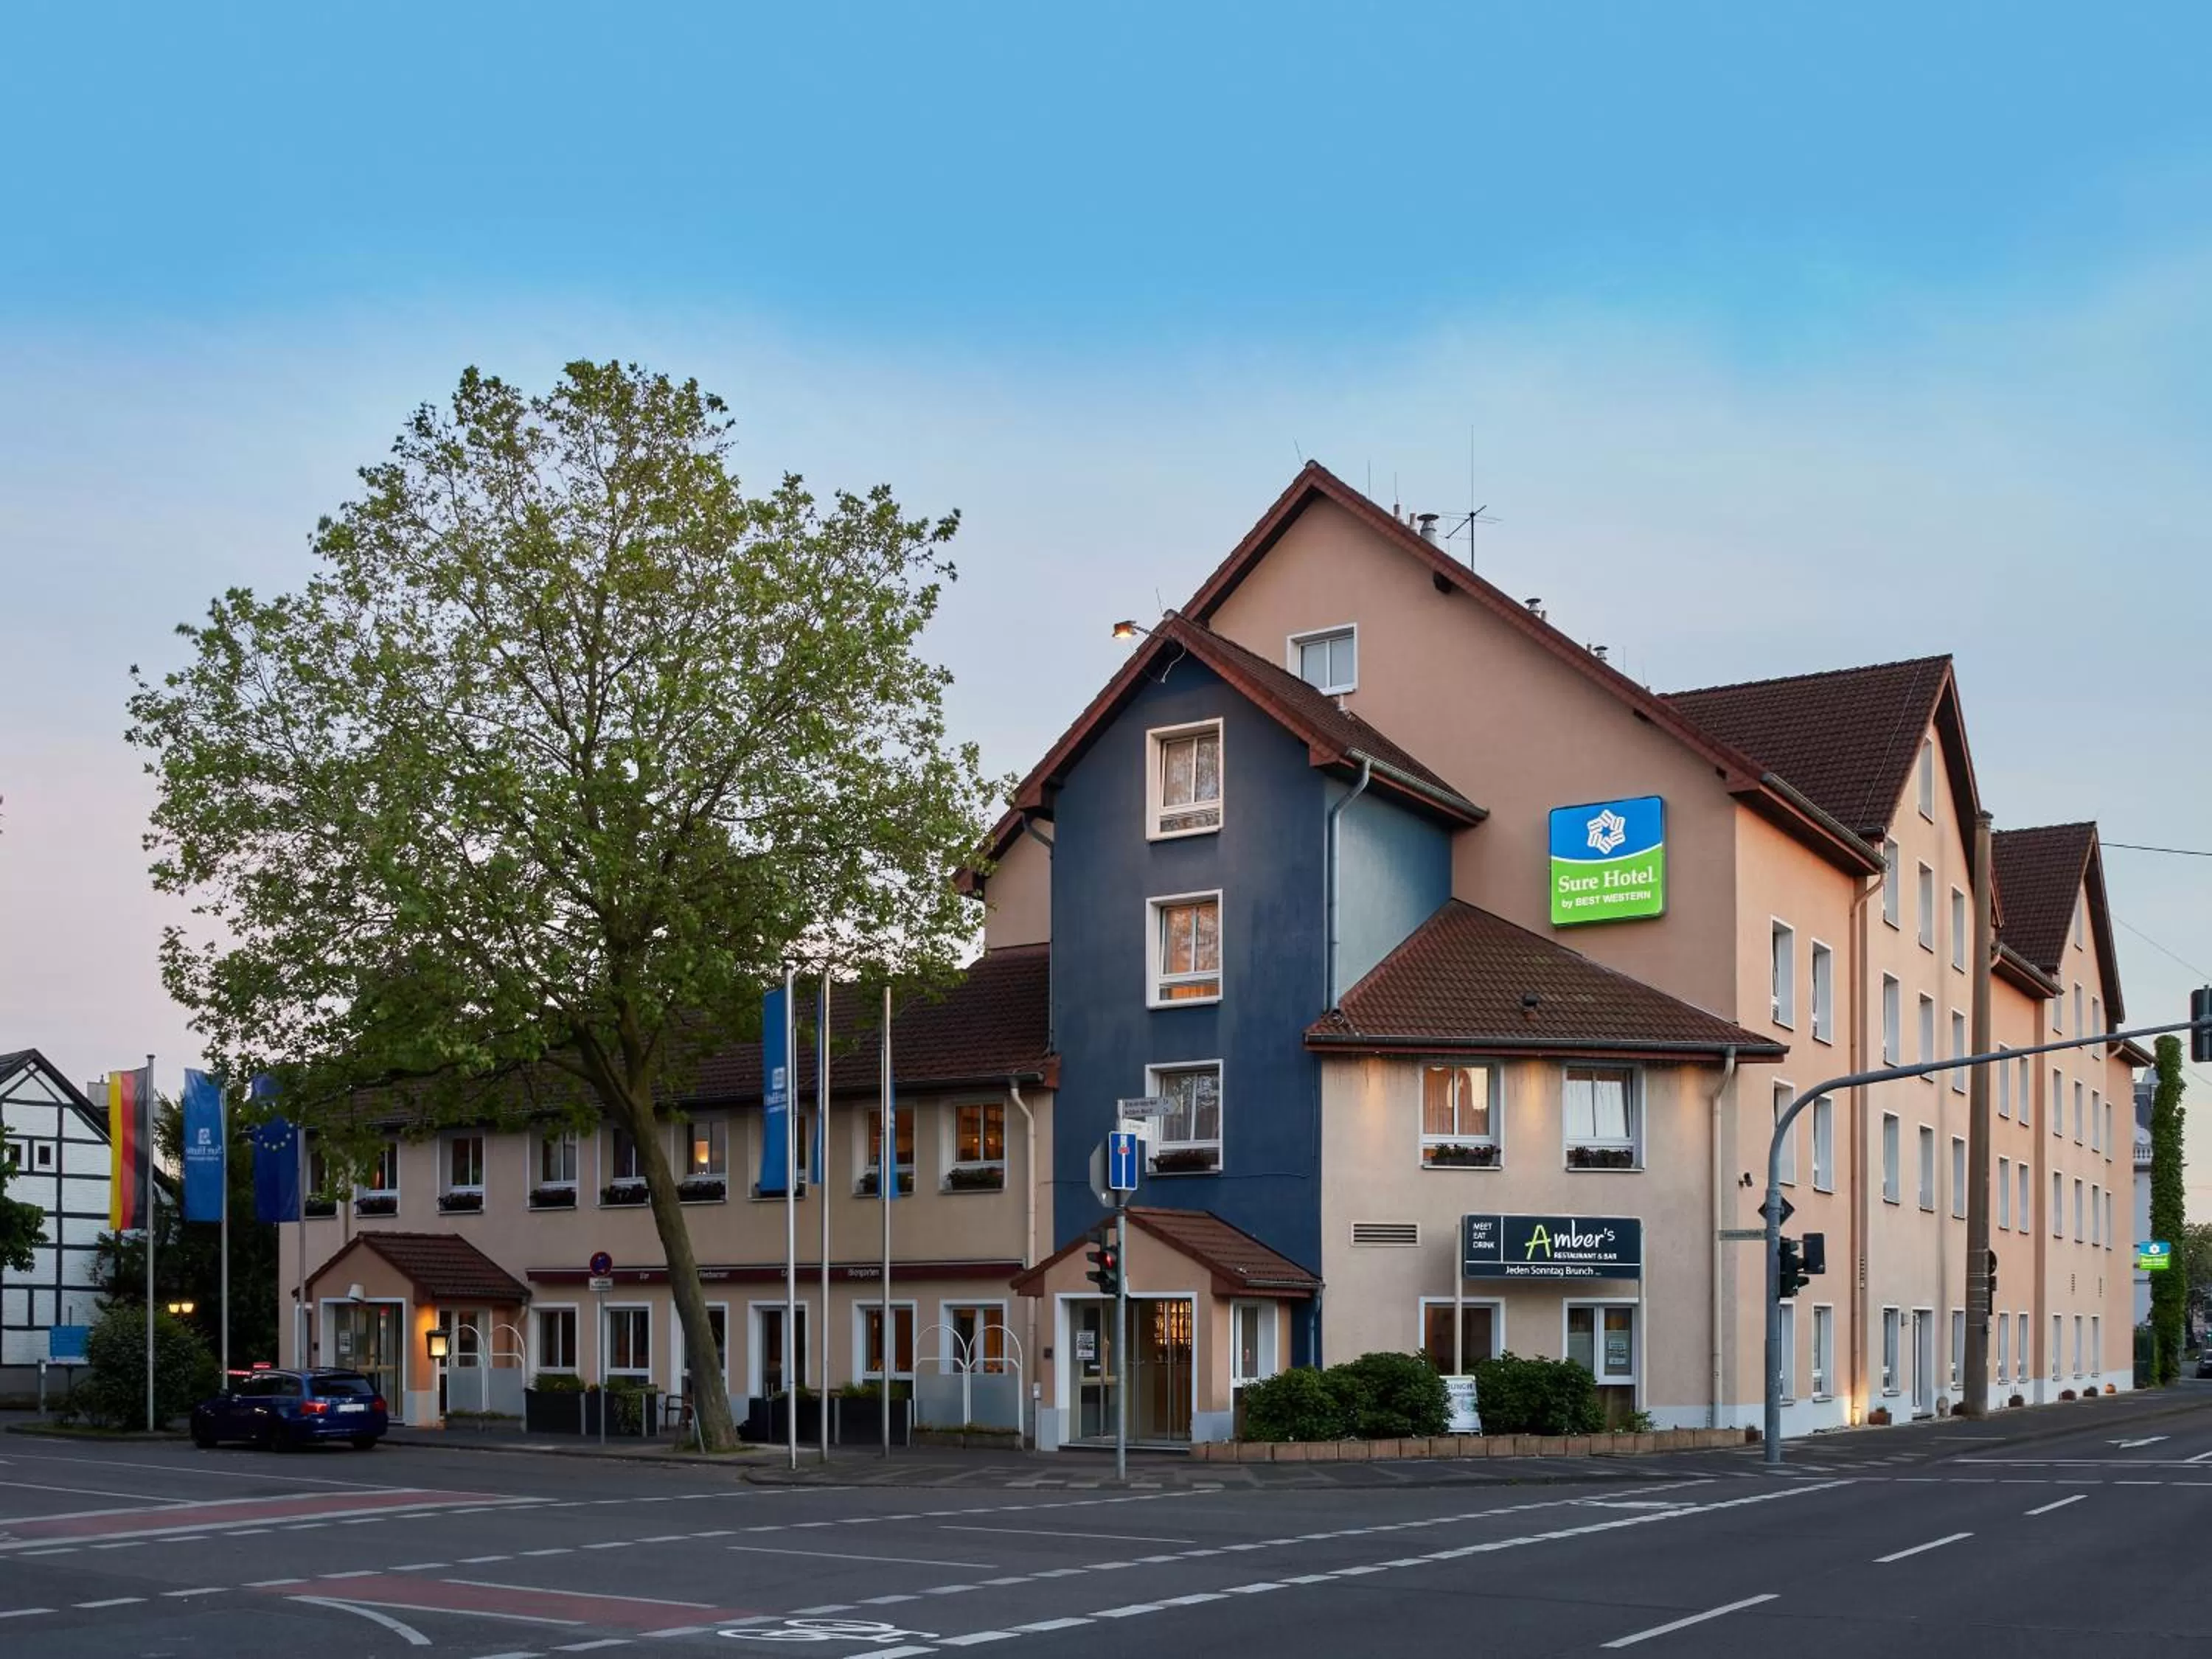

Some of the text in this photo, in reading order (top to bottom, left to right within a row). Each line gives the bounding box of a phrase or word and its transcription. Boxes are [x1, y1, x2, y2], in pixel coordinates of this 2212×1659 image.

[1558, 866, 1655, 893] Sure Hotel
[1561, 890, 1651, 908] by BEST WESTERN
[1473, 1222, 1492, 1231] MEET
[1525, 1219, 1615, 1260] Amber's
[1505, 1265, 1530, 1275] Jeden
[1530, 1265, 1564, 1276] Sonntag
[1565, 1266, 1594, 1276] Brunch
